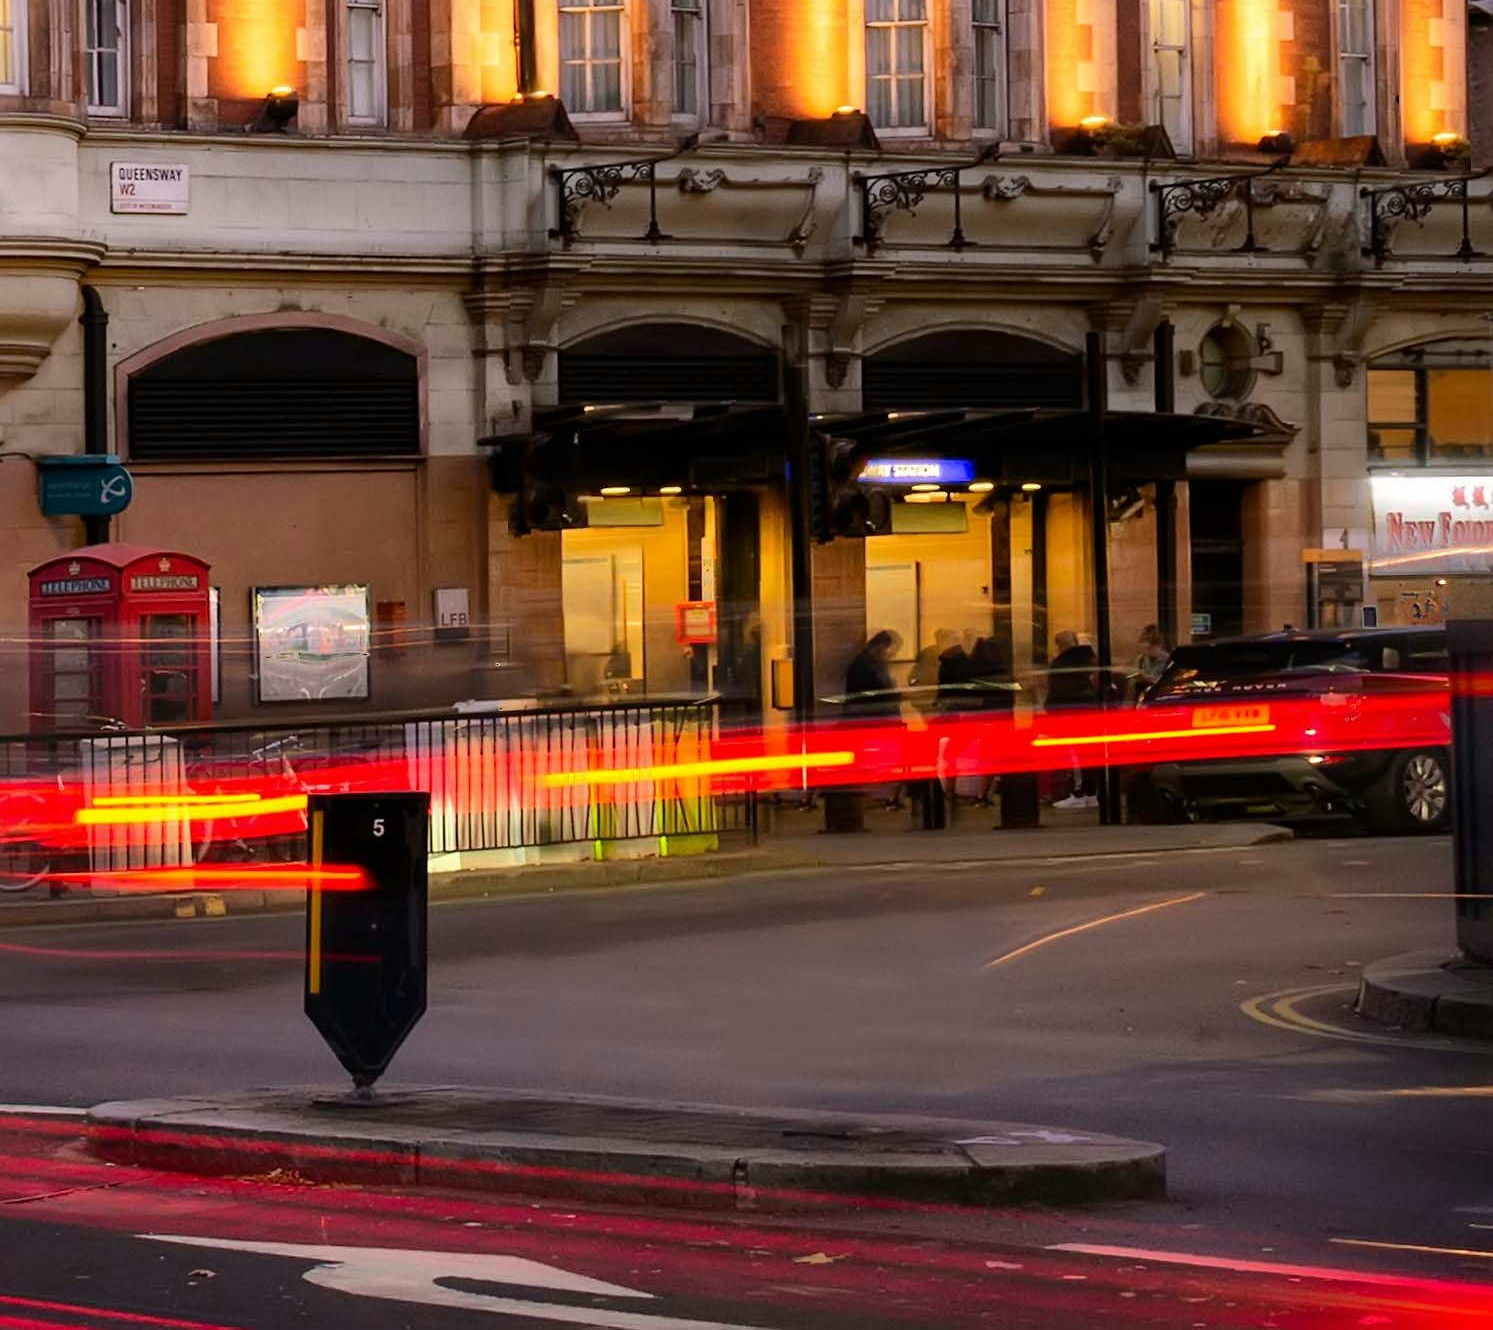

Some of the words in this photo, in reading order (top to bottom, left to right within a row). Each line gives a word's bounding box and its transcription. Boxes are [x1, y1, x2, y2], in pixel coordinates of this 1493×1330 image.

[118, 167, 183, 181] QUEENSWAY
[119, 183, 136, 196] W2
[44, 580, 110, 594] TELEPHONE
[133, 577, 196, 589] TELEPHONE
[441, 612, 468, 627] LFB
[372, 818, 385, 837] 5
